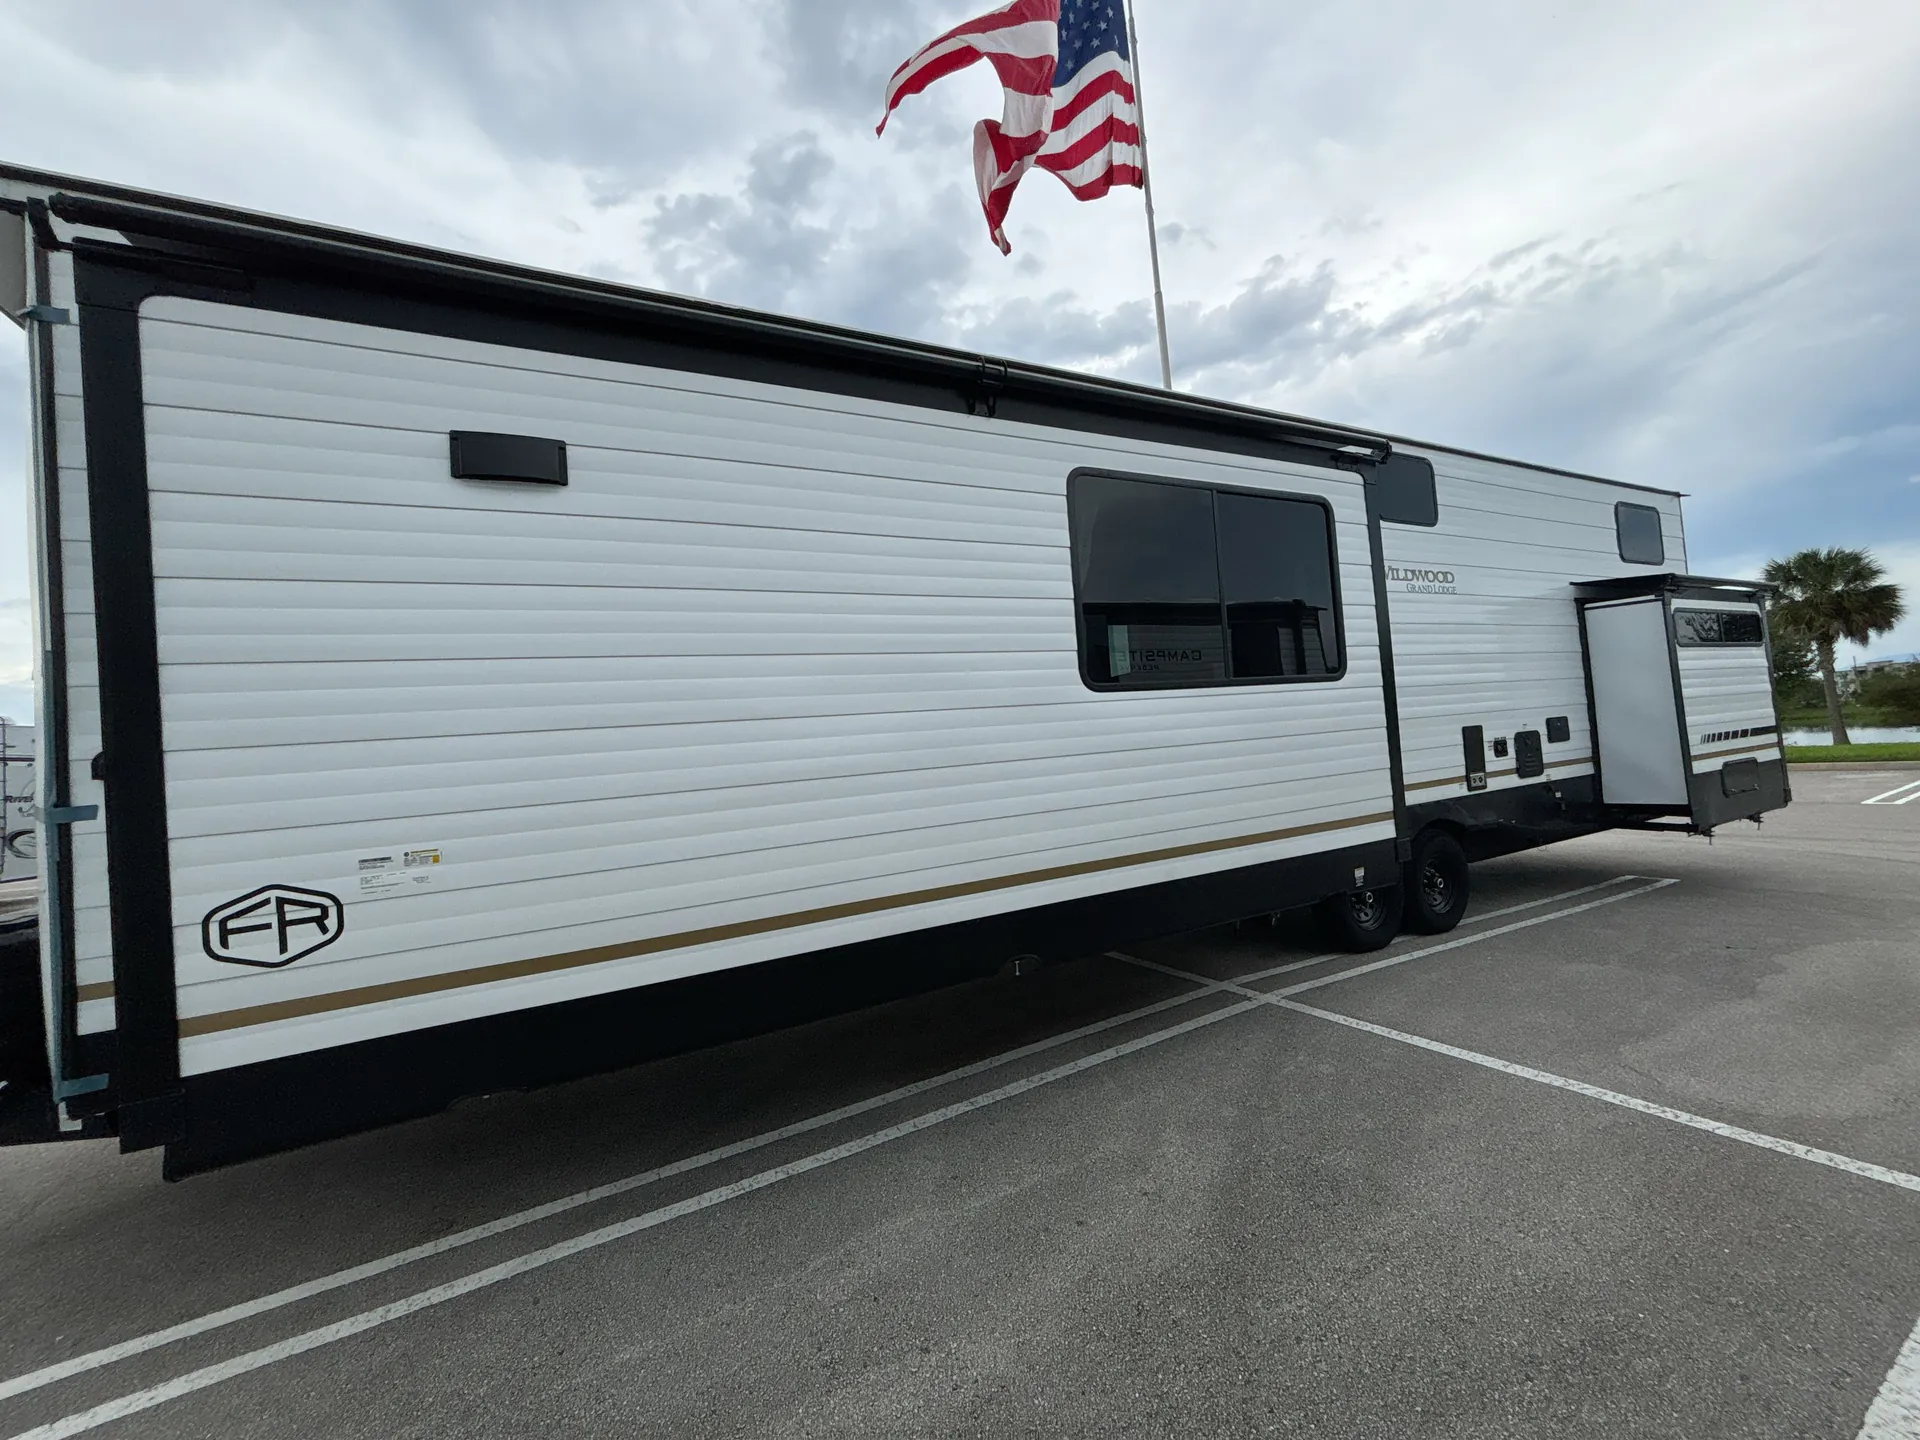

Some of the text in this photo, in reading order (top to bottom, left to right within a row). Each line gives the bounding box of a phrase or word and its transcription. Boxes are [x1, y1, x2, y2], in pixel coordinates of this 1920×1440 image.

[1406, 583, 1457, 594] GRAND LODGE
[219, 896, 329, 955] FR
